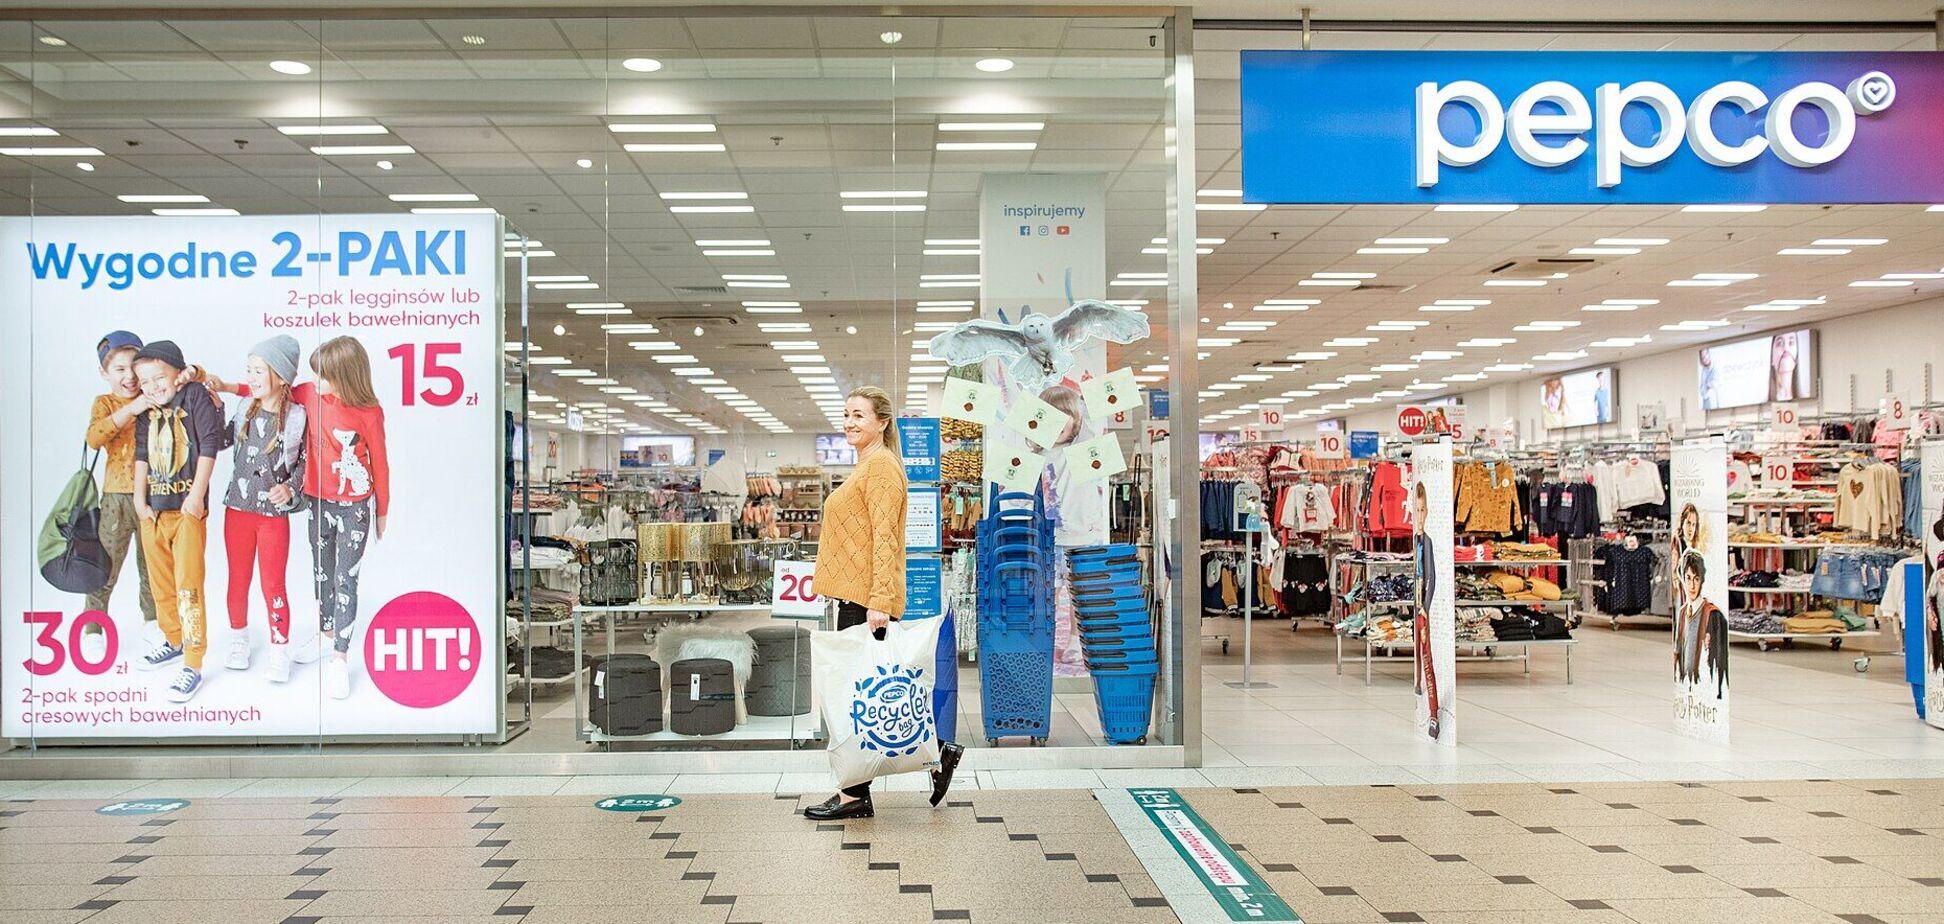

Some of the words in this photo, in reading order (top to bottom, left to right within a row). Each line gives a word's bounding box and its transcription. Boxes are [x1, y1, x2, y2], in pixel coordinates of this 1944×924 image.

[1416, 81, 1856, 188] pepco
[1004, 204, 1085, 219] inspirujemy
[26, 242, 257, 290] Wygodne
[271, 229, 466, 277] 2-PAKI
[287, 290, 343, 309] 2-pak
[350, 288, 445, 309] legginsów
[451, 288, 480, 305] lub
[264, 311, 341, 328] koszulek
[348, 310, 480, 328] bawełnianych
[388, 342, 465, 407] 15
[466, 392, 478, 407] zł
[1264, 411, 1279, 424] 10
[1777, 410, 1794, 424] 10
[1893, 401, 1902, 419] 8
[1400, 415, 1424, 427] HIT!
[1321, 437, 1339, 452] 10
[1767, 465, 1787, 481] 10
[780, 575, 818, 602] 20
[22, 610, 119, 676] 30
[116, 661, 128, 675] zł
[373, 627, 472, 672] HIT!
[22, 687, 78, 707] 2-pak
[83, 686, 147, 706] spodni
[130, 706, 261, 726] bawełnianych
[898, 718, 915, 738] bag
